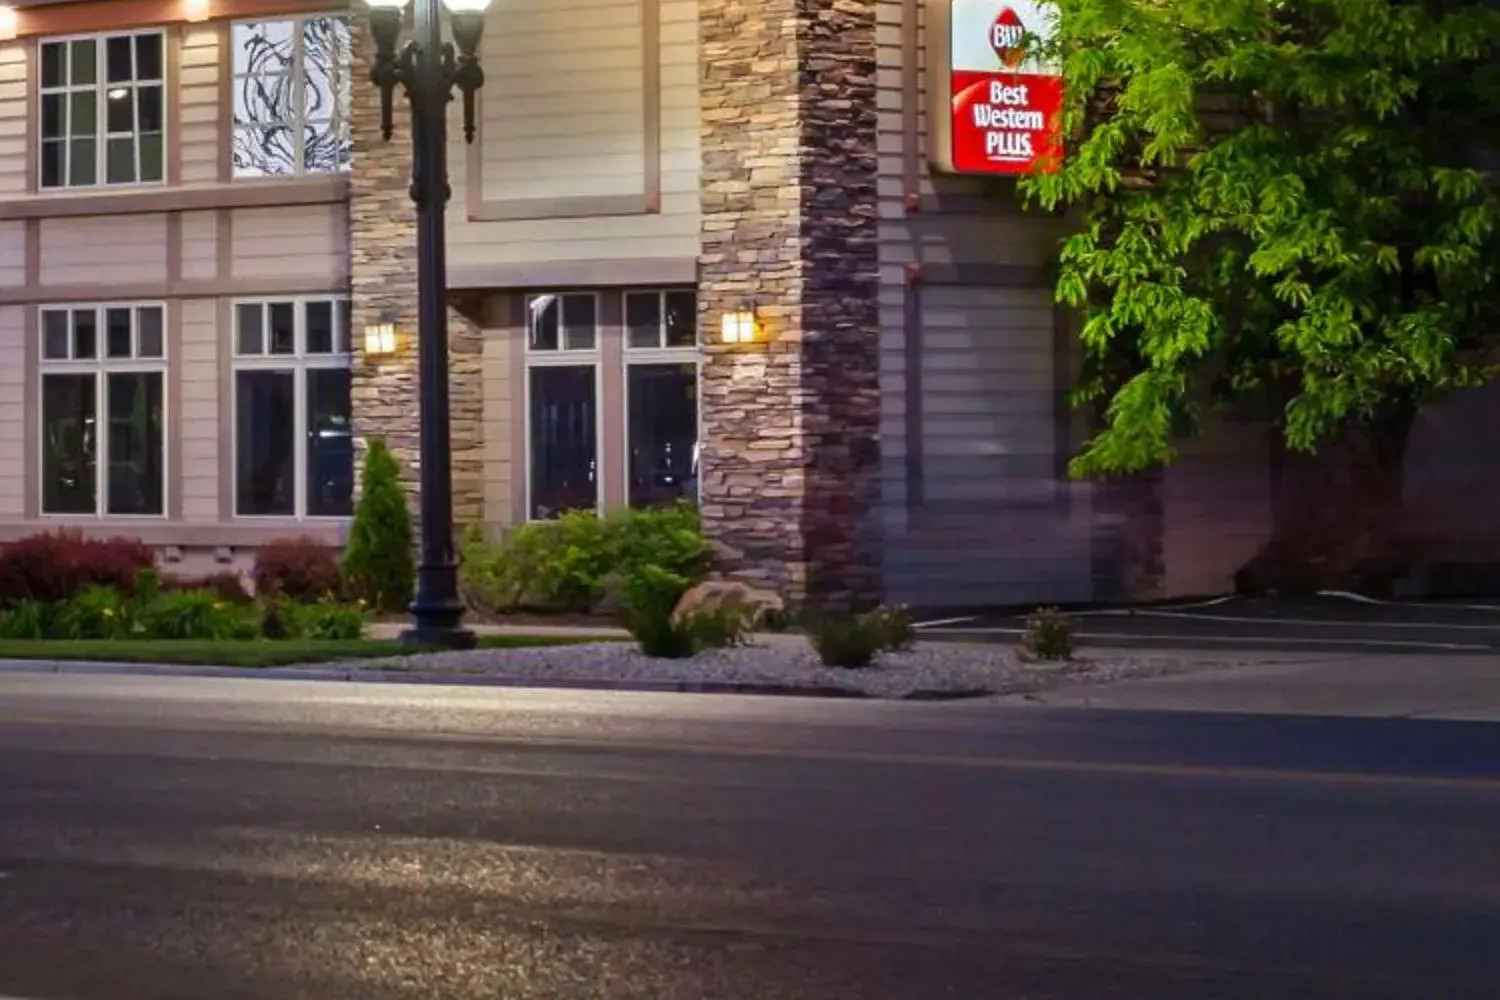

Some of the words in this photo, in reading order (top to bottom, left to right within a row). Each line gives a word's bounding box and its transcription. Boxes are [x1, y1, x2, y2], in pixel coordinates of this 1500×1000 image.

[994, 24, 1022, 48] BW
[990, 81, 1028, 105] Best
[973, 103, 1044, 129] Western
[986, 132, 1032, 155] PLUS
